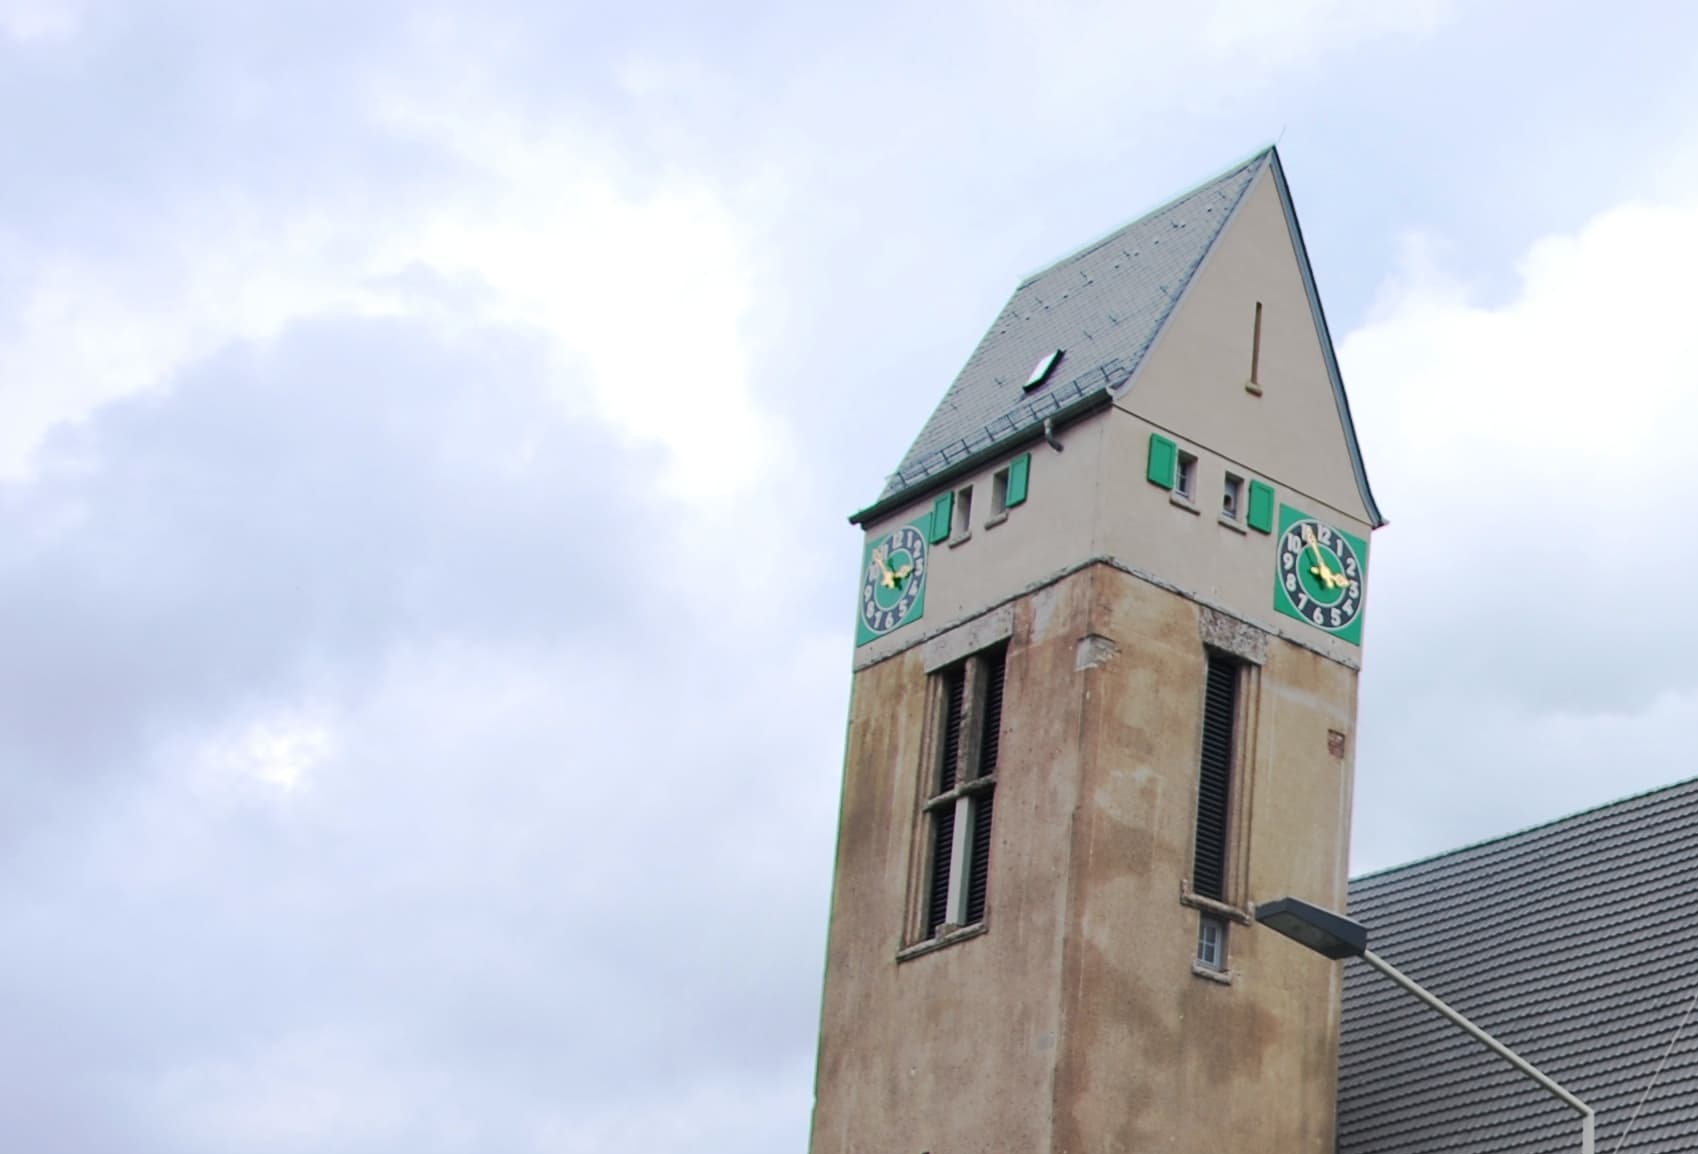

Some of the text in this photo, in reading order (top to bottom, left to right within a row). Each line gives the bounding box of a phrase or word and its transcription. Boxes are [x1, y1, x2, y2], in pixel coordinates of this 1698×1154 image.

[1287, 532, 1301, 554] 10
[1317, 524, 1331, 545] 12
[1336, 539, 1343, 557] 1
[1283, 552, 1293, 570] 9
[1346, 557, 1356, 577] 2
[1286, 573, 1296, 592] 8
[1348, 580, 1359, 599] 3
[1298, 593, 1308, 610] 7
[1342, 598, 1354, 616] 4
[1313, 607, 1324, 625] 6
[1330, 607, 1341, 627] 5
